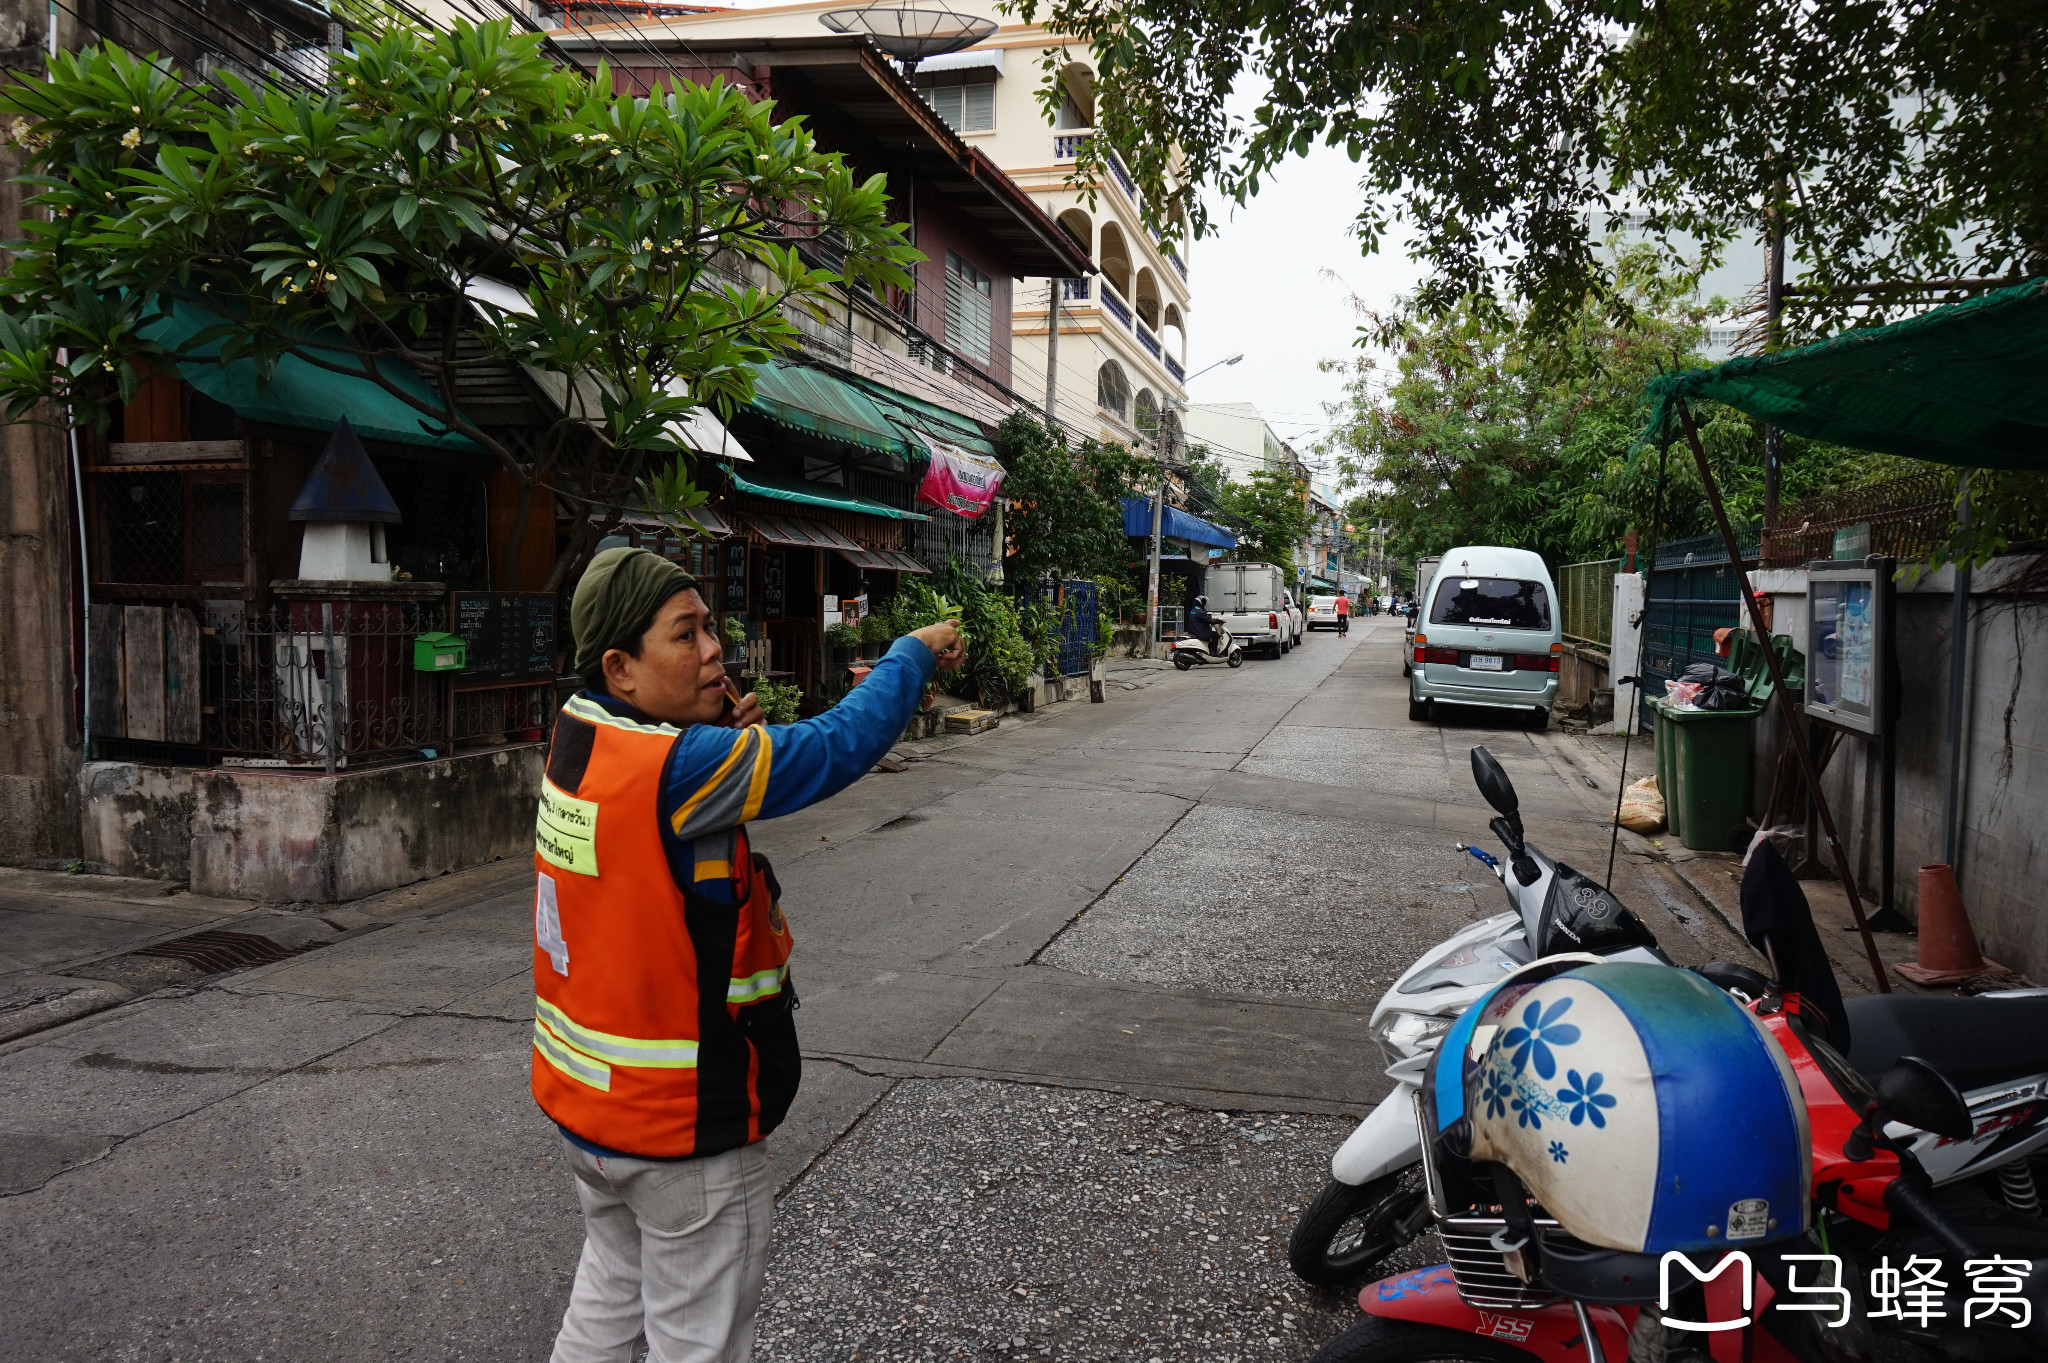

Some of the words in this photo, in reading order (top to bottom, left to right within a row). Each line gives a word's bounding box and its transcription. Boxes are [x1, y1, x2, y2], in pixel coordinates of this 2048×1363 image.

[1484, 656, 1501, 665] 9613
[1574, 887, 1610, 920] 39
[536, 871, 570, 977] 4
[1554, 917, 1582, 945] HONDA
[1475, 1310, 1535, 1337] YSS
